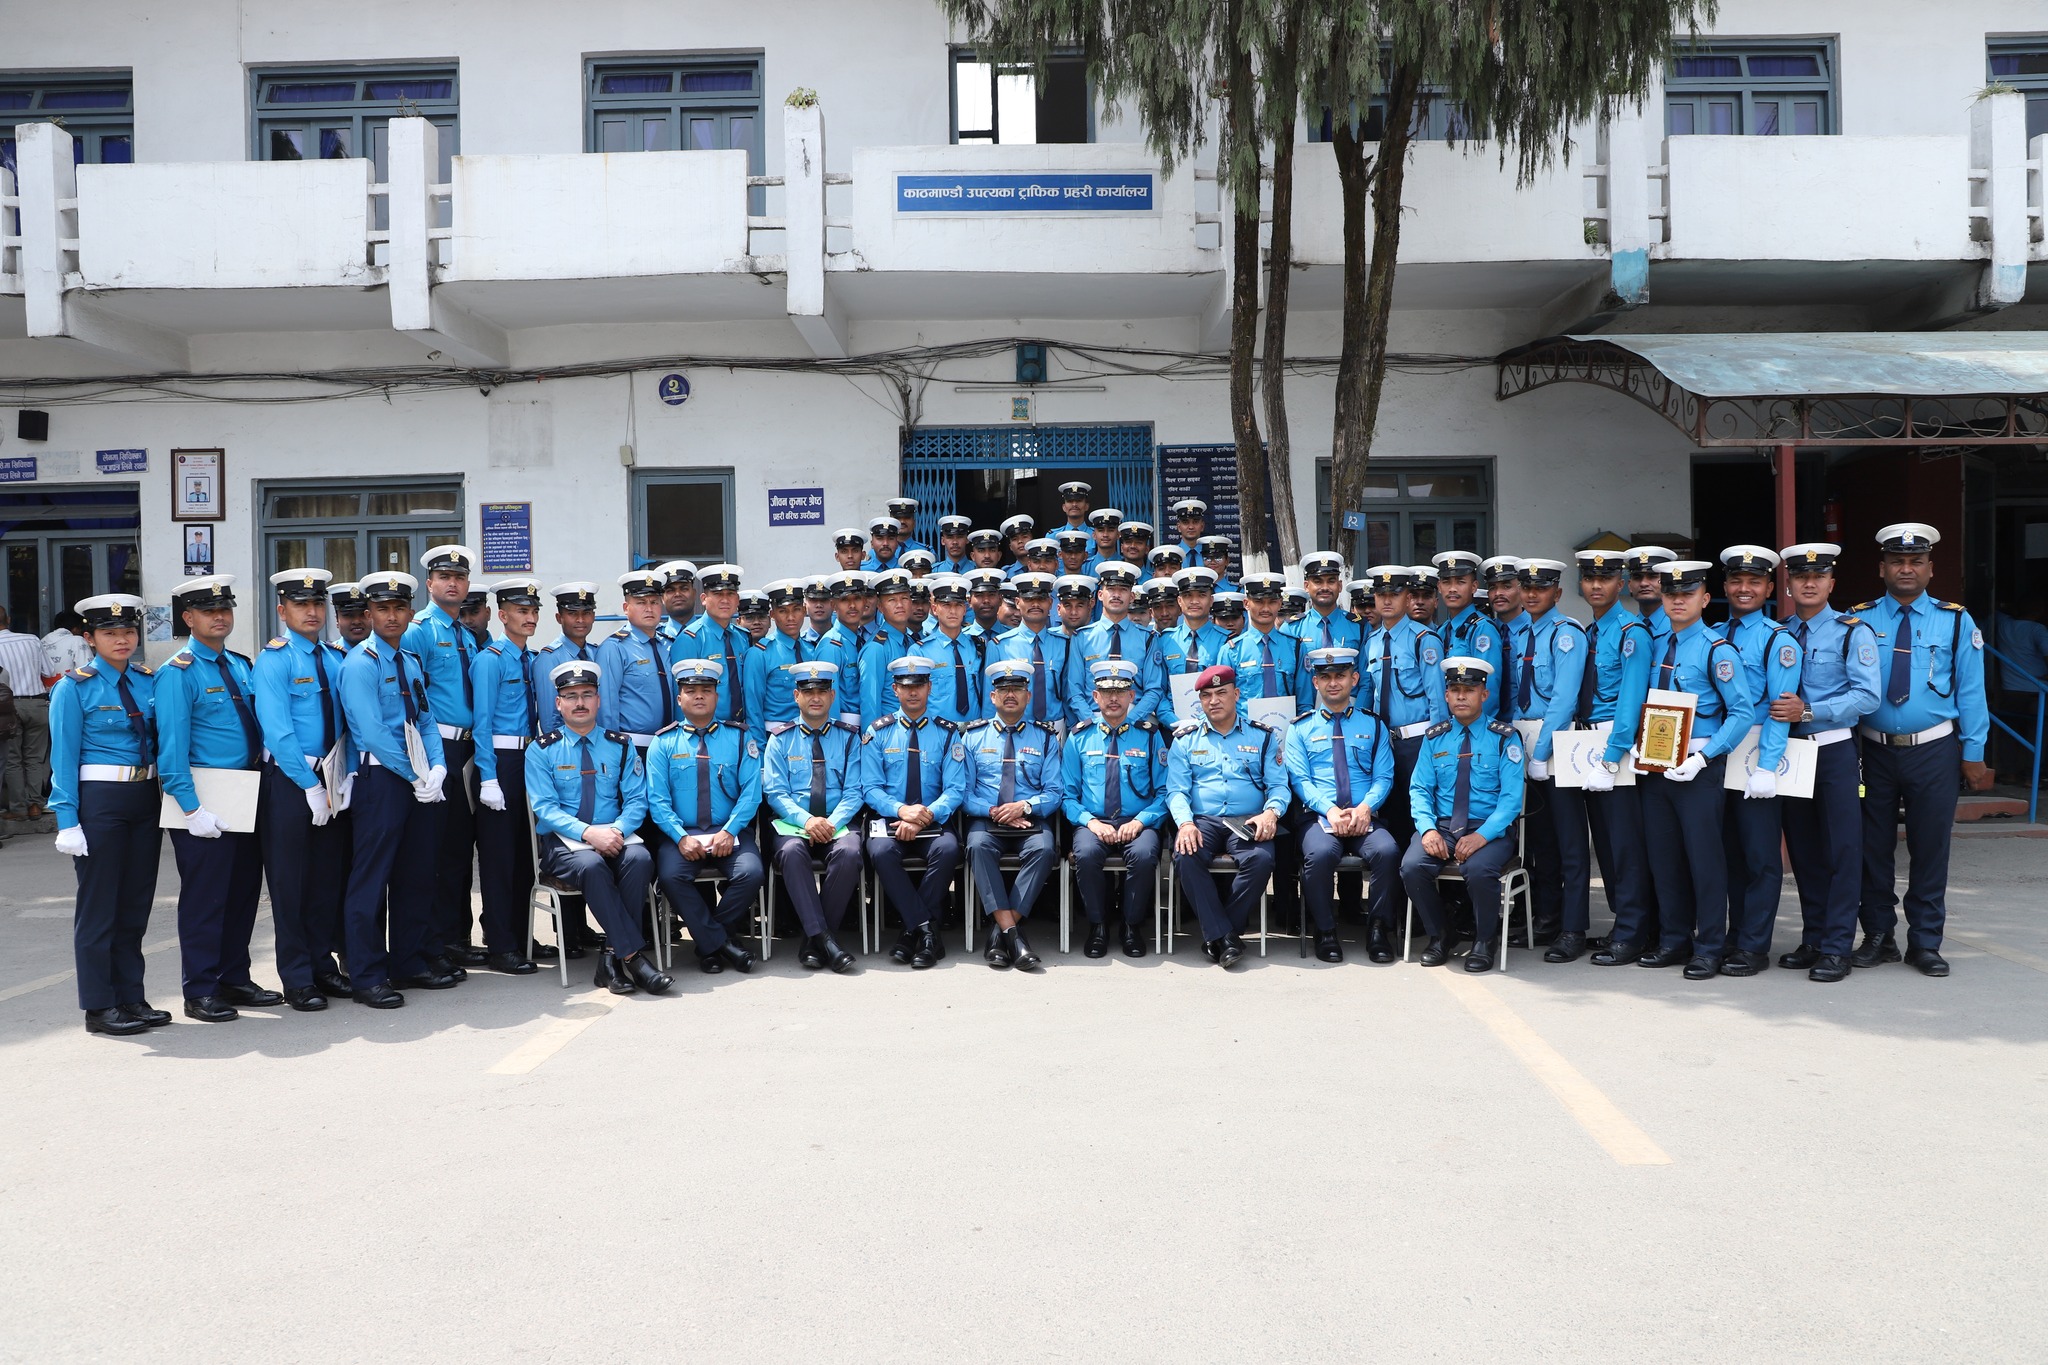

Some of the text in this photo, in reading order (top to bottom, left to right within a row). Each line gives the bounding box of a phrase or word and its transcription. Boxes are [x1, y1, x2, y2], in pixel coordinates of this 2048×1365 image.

[966, 187, 1015, 199] उपत्यका
[1018, 185, 1060, 200] ट्राफिक
[1063, 185, 1092, 199] प्रहरी
[1096, 184, 1149, 198] कार्यालय
[668, 379, 680, 393] २
[770, 495, 788, 507] जीवन
[789, 497, 808, 509] कुमार
[772, 511, 785, 521] प्रहरी
